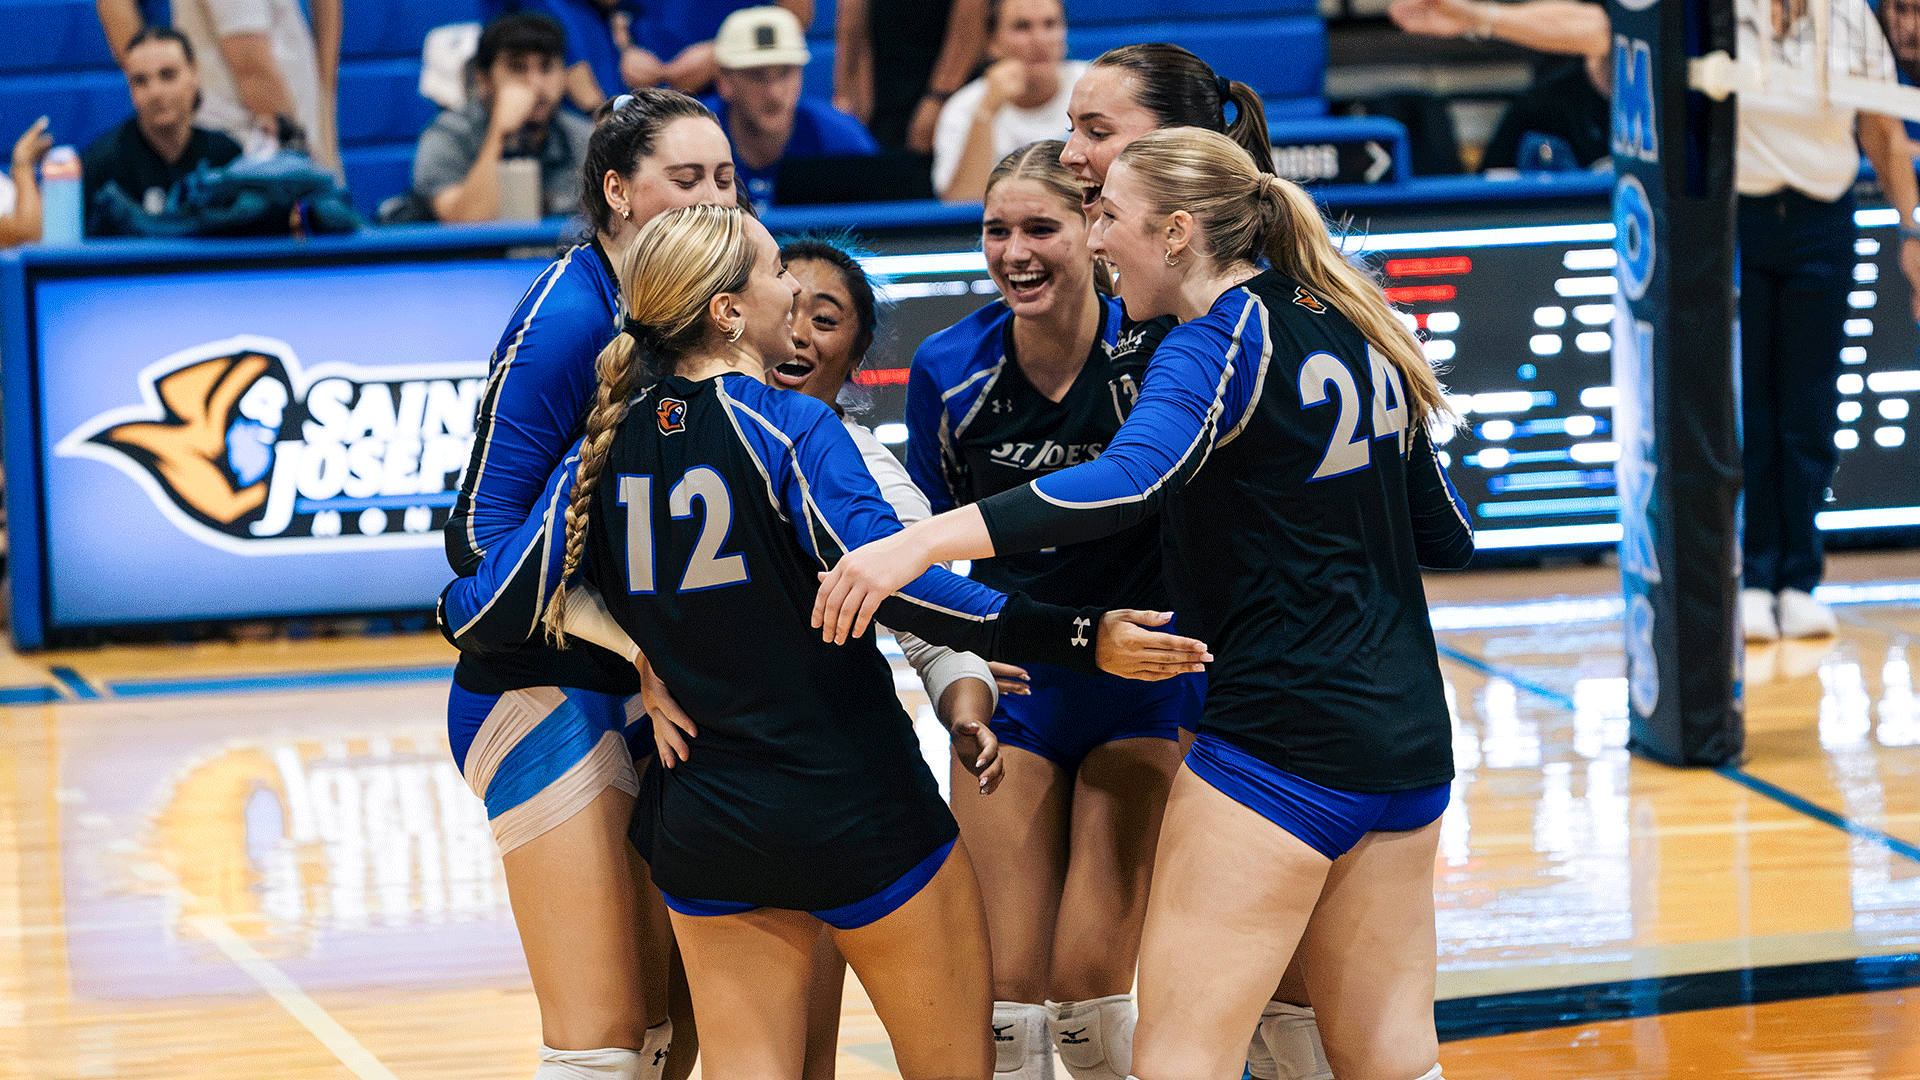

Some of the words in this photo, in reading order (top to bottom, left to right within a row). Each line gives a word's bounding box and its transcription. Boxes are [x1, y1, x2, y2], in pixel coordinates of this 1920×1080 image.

[302, 378, 488, 445] SAIN
[1297, 341, 1409, 483] 24
[249, 439, 477, 537] JOSEP
[311, 504, 455, 537] MON
[616, 464, 752, 595] 12
